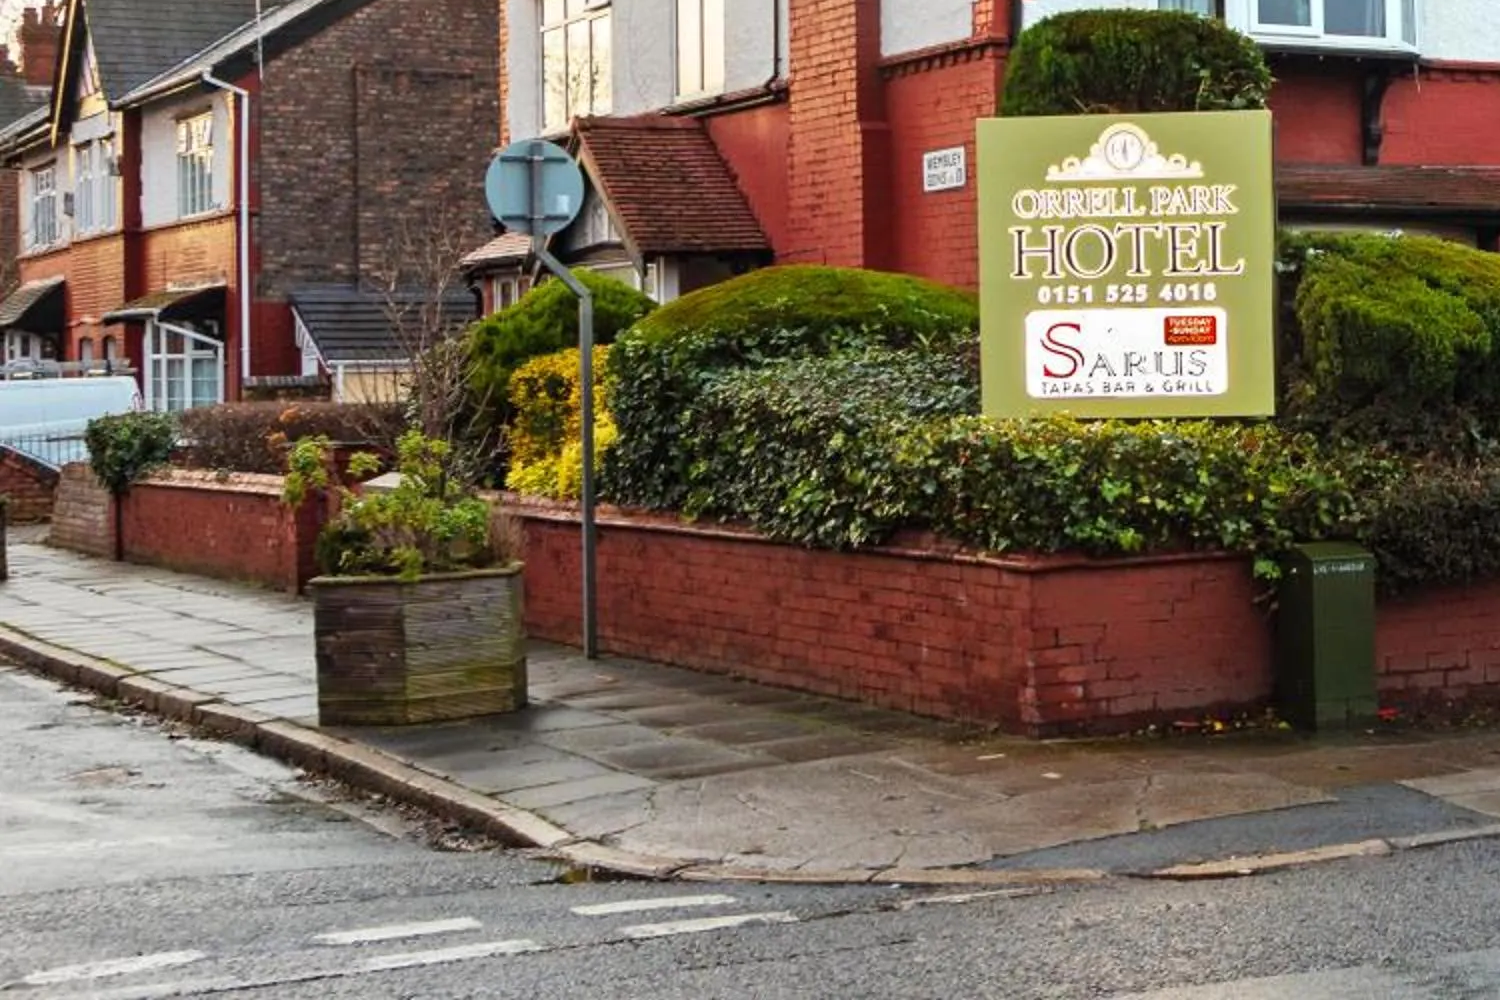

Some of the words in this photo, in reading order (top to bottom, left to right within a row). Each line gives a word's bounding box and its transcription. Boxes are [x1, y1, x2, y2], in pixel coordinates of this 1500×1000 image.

[1011, 187, 1146, 219] ORRELL
[1149, 184, 1239, 215] PARK
[1008, 221, 1246, 279] HOTEL
[1037, 285, 1093, 303] 0151
[1105, 284, 1149, 303] 525
[1041, 382, 1095, 395] TAPAS
[1103, 381, 1136, 393] BAR
[1145, 381, 1155, 393] &
[1162, 380, 1213, 393] GRILL
